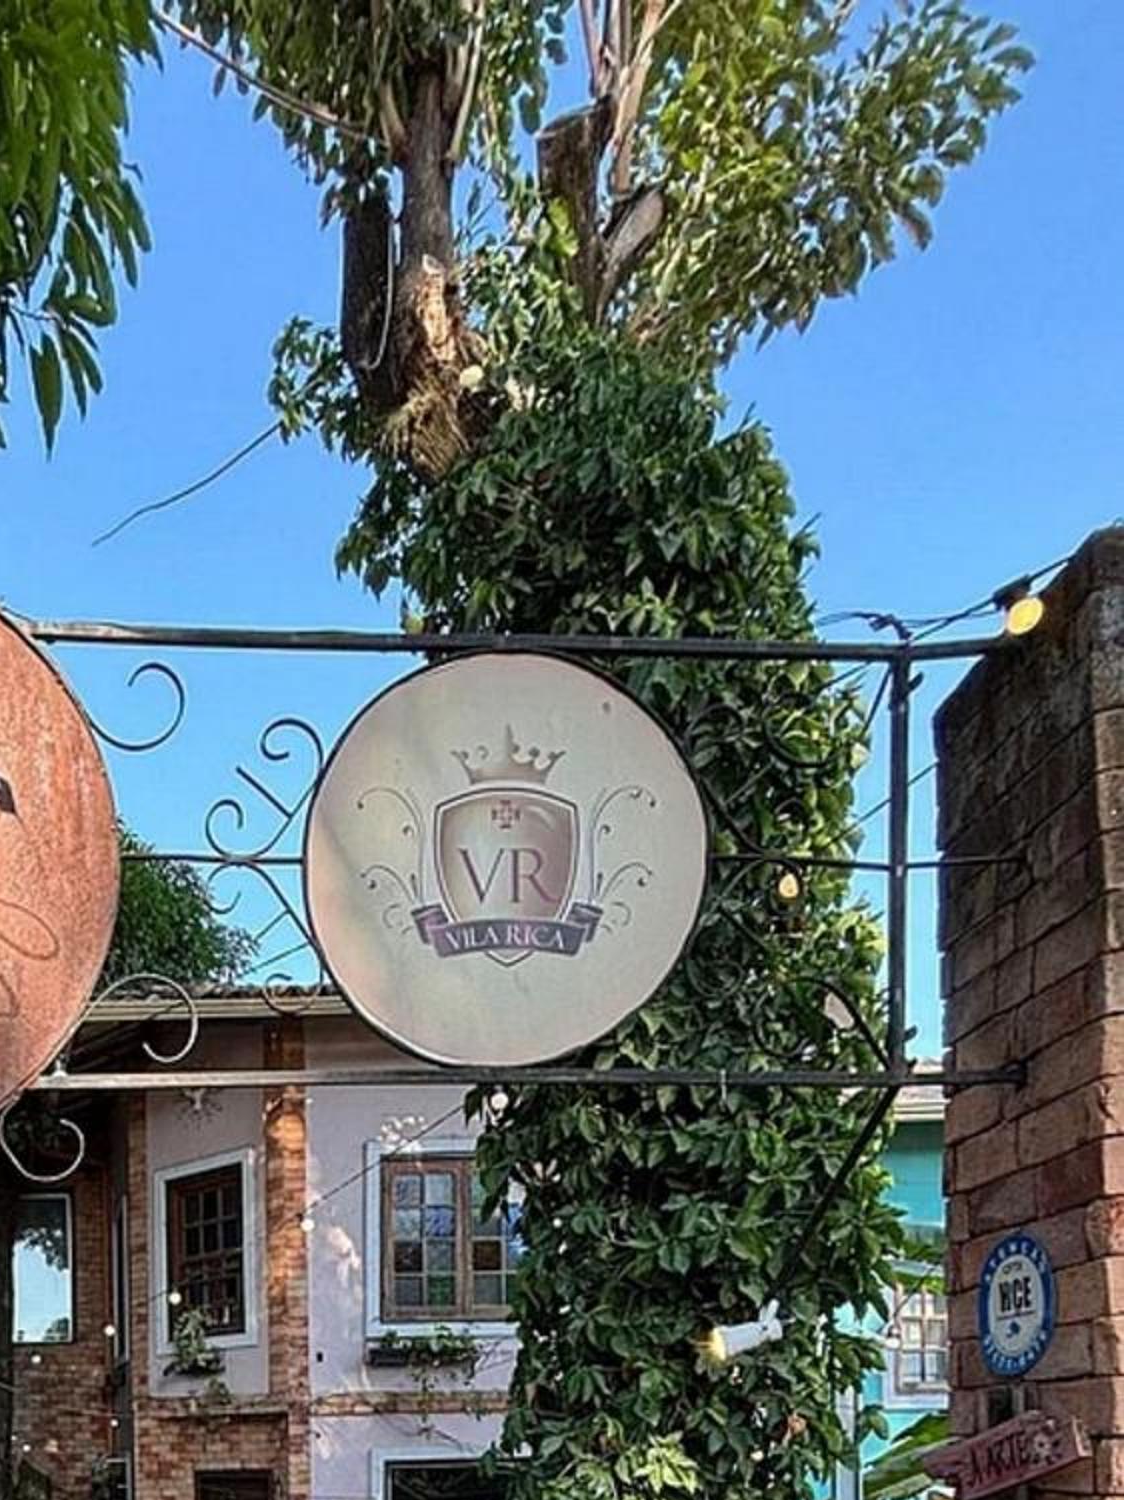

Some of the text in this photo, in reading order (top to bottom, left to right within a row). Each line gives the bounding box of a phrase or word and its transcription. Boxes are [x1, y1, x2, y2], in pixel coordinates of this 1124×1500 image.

[458, 846, 564, 904] VR
[445, 925, 566, 950] VILA RICA
